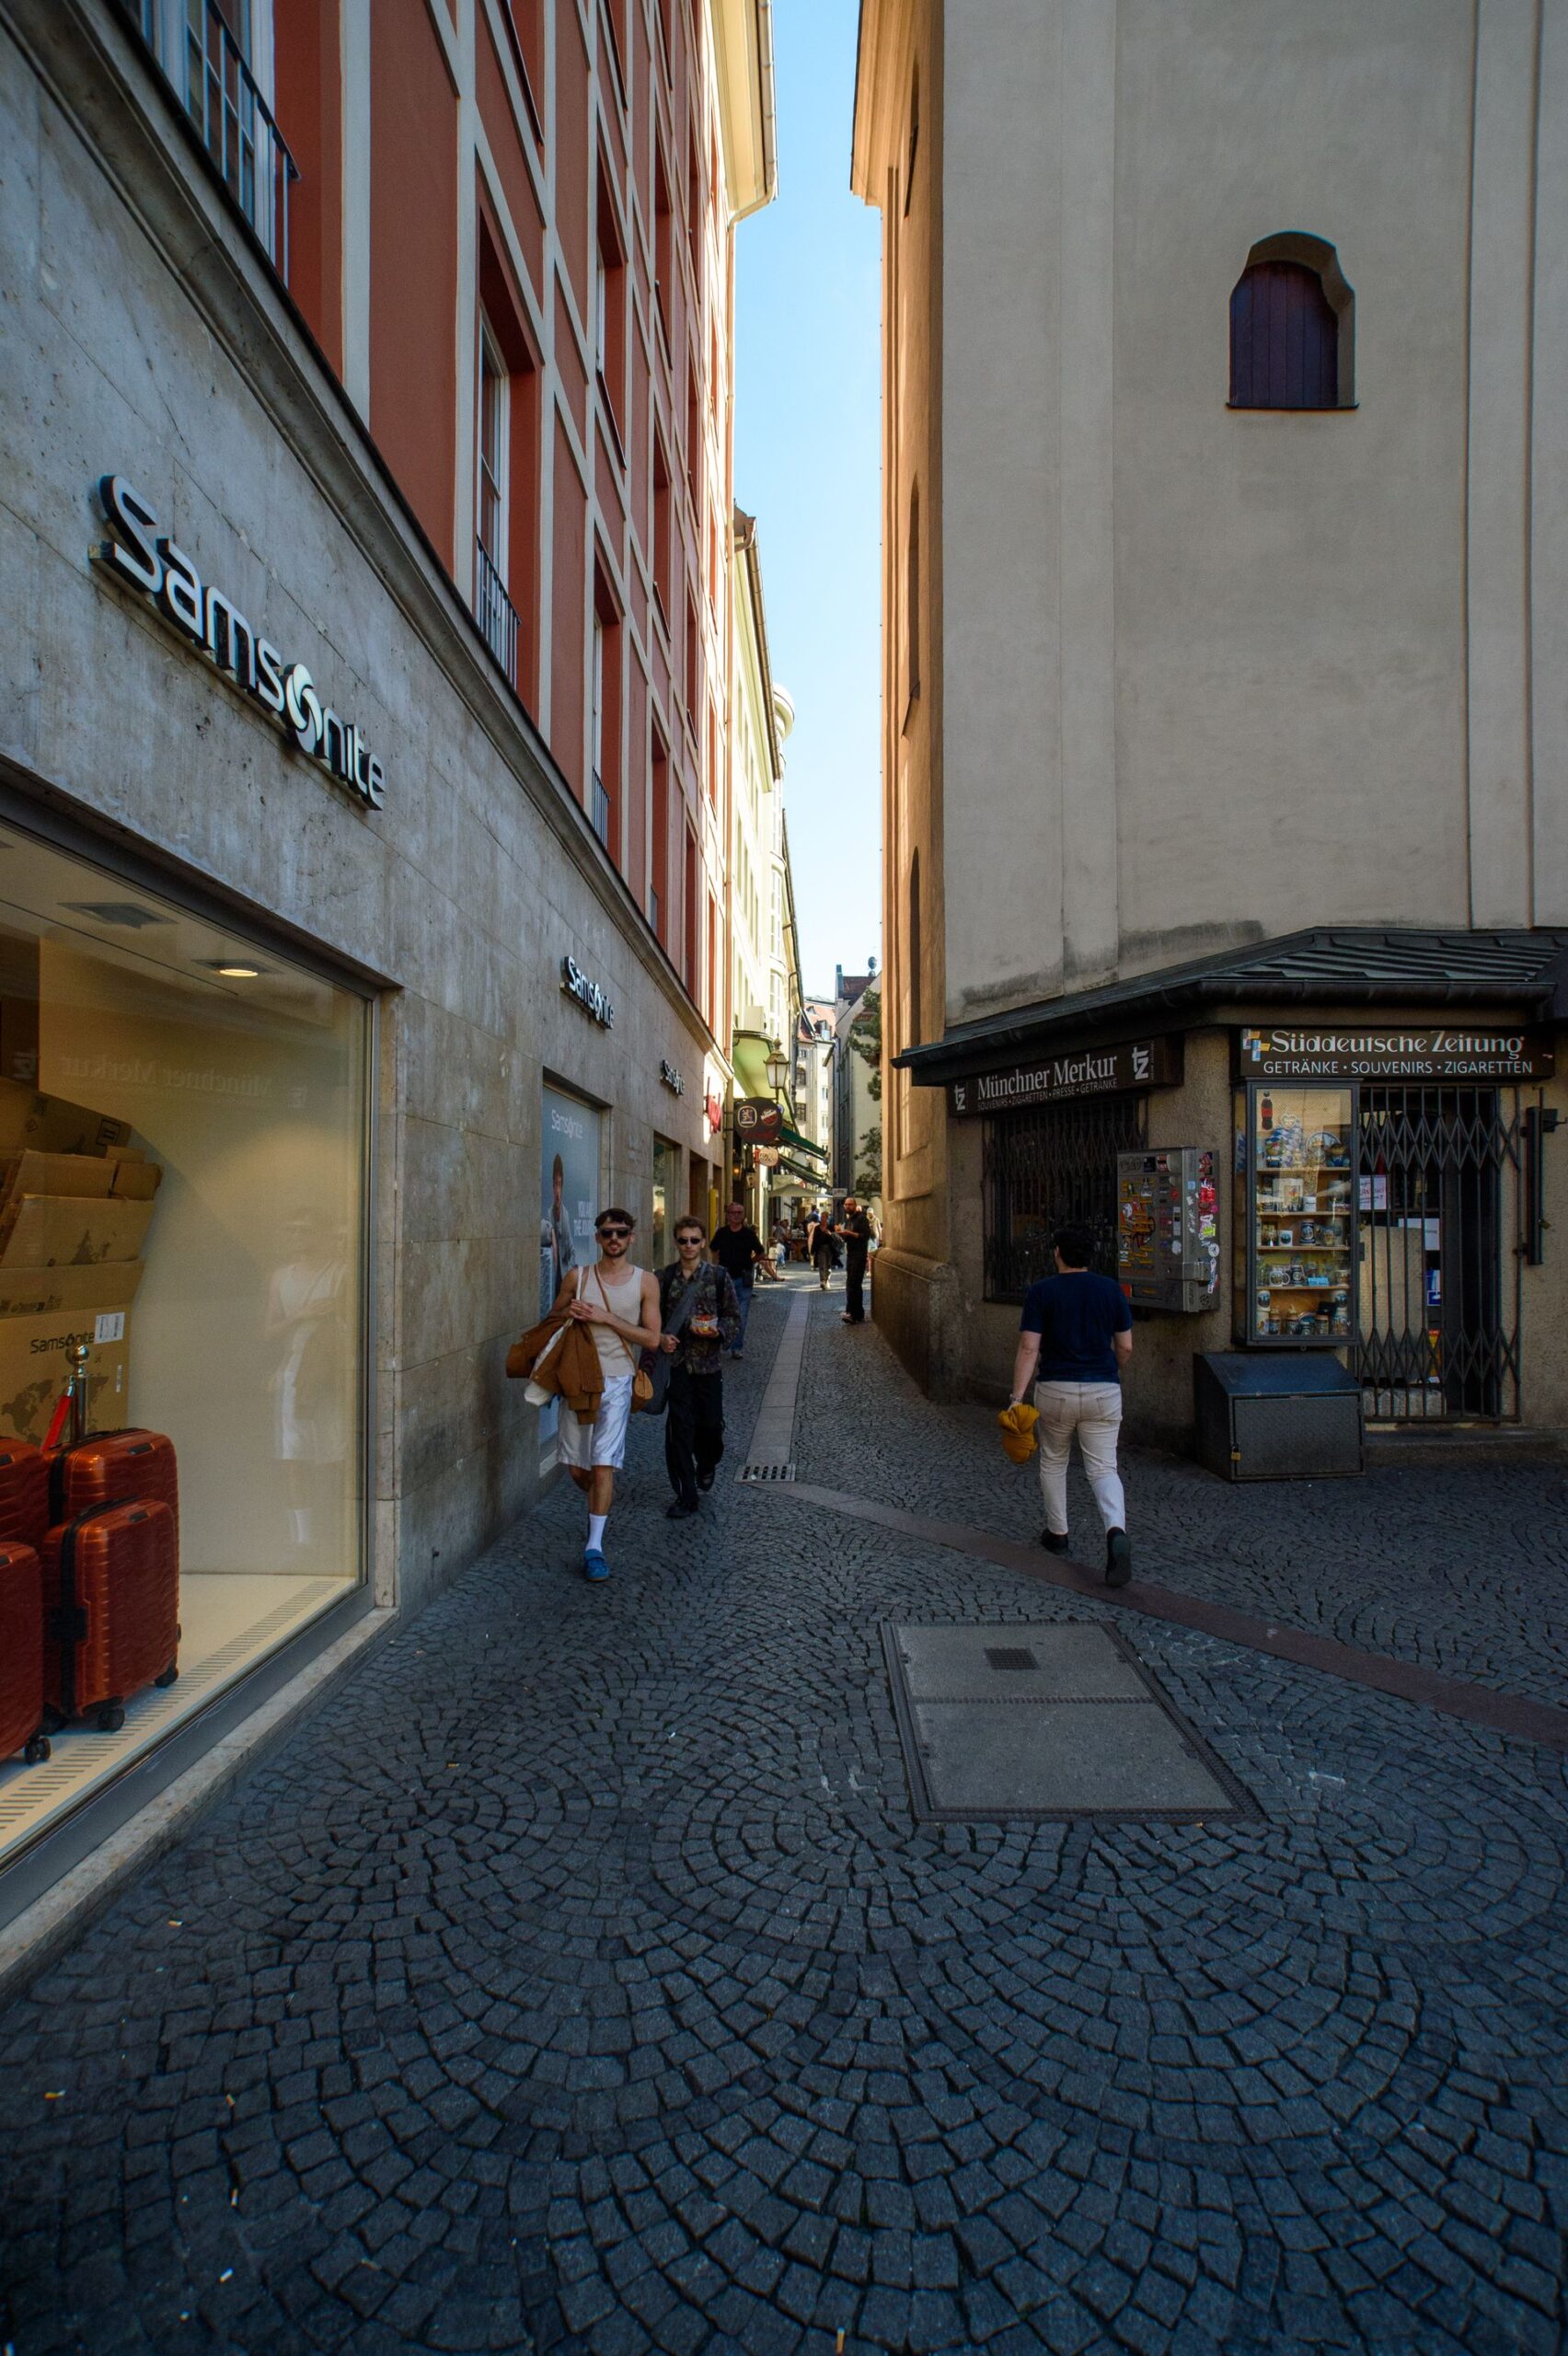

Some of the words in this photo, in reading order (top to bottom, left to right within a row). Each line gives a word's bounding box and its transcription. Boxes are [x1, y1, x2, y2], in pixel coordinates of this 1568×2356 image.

[96, 474, 386, 811] Samsonite
[564, 955, 615, 1029] Samsonite
[1270, 1030, 1427, 1054] Süddeutsche
[1431, 1030, 1525, 1060] Zeitung
[977, 1068, 1050, 1101] Münchner
[1054, 1053, 1117, 1086] Merkur
[1263, 1057, 1339, 1075] GETRÄNKE
[1351, 1060, 1433, 1074] SOUVENIRS
[1444, 1060, 1532, 1074] ZIGARETTEN
[977, 1096, 1009, 1112] SOUVENIRS
[1012, 1091, 1049, 1107] ZIGARETTEN
[1052, 1085, 1076, 1098] PRESSE
[1079, 1078, 1118, 1096] GETRÄNKE
[29, 1332, 95, 1354] Samsonite
